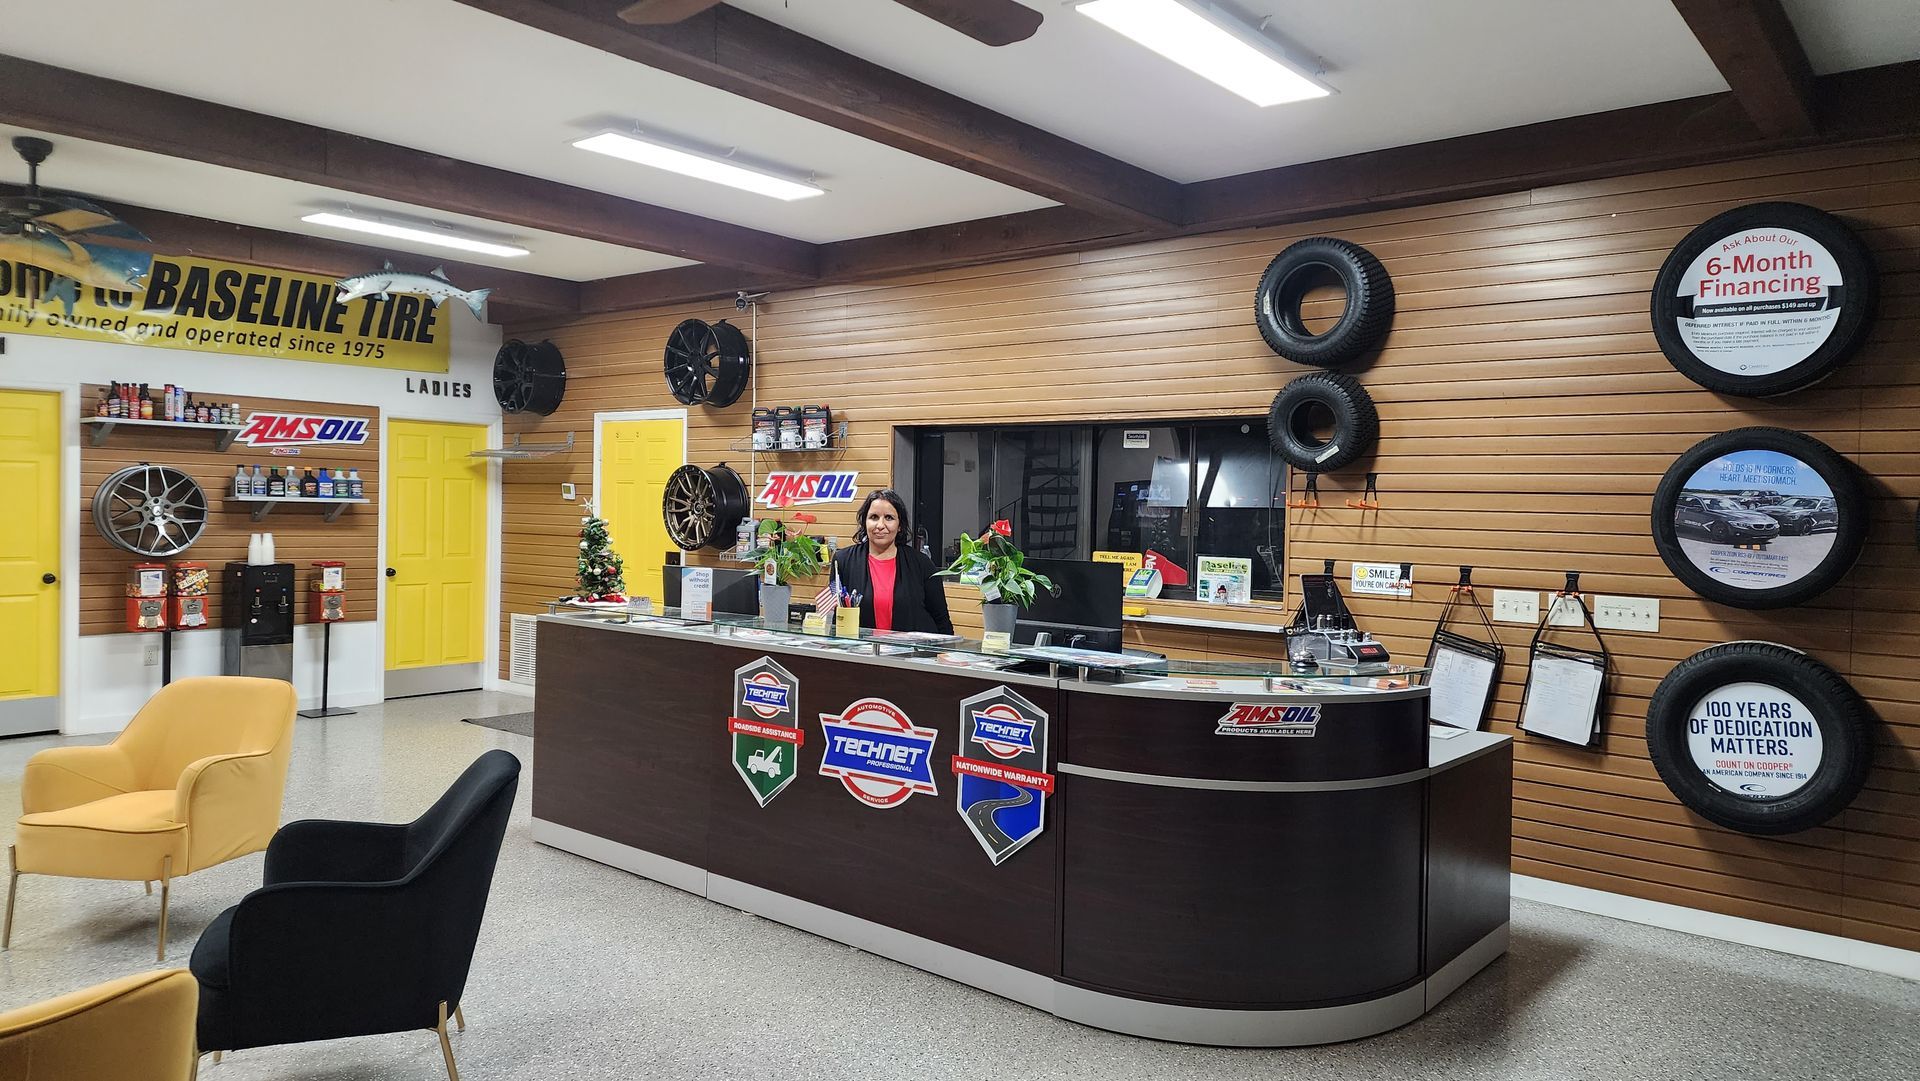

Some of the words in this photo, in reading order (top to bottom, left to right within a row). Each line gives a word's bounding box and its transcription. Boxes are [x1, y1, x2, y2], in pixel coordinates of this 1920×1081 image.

[1722, 240, 1742, 252] Ask
[1744, 234, 1776, 244] About
[1778, 234, 1798, 246] Our
[1706, 250, 1812, 276] 6-Month
[1700, 274, 1821, 298] Financing
[143, 260, 348, 334] BASELINE
[358, 292, 437, 343] TIRE
[1753, 304, 1781, 312] purchases
[47, 313, 128, 332] owned
[136, 321, 179, 339] and
[185, 326, 282, 349] operated
[288, 335, 336, 354] since
[342, 341, 385, 359] 1975
[406, 378, 472, 398] LADIES
[240, 415, 365, 444] AMSOIL
[1743, 474, 1761, 483] MEET
[762, 474, 855, 504] AMSOIL
[1369, 569, 1395, 579] SMILE
[1355, 580, 1374, 588] YOU'RE
[1375, 581, 1384, 589] ON
[856, 704, 896, 717] AUTOMOTIVE
[1226, 705, 1318, 725] AMSOIL
[1706, 701, 1731, 717] 100
[1736, 702, 1792, 718] YEARS
[733, 722, 761, 733] ROADSIDE
[762, 727, 797, 740] ASSISTANCE
[1690, 719, 1708, 734] OF
[1714, 719, 1813, 738] DEDICATION
[1710, 737, 1794, 756] MATTERS.
[866, 760, 913, 772] PROFESSIONAL
[956, 761, 1002, 777] NATIONWIDE
[1004, 771, 1048, 786] WARRANTY
[1712, 769, 1743, 777] AMERICAN
[1744, 770, 1775, 778] COMPANY
[1716, 760, 1740, 769] COUNT
[1744, 761, 1755, 770] ON
[862, 794, 889, 803] SERVICE
